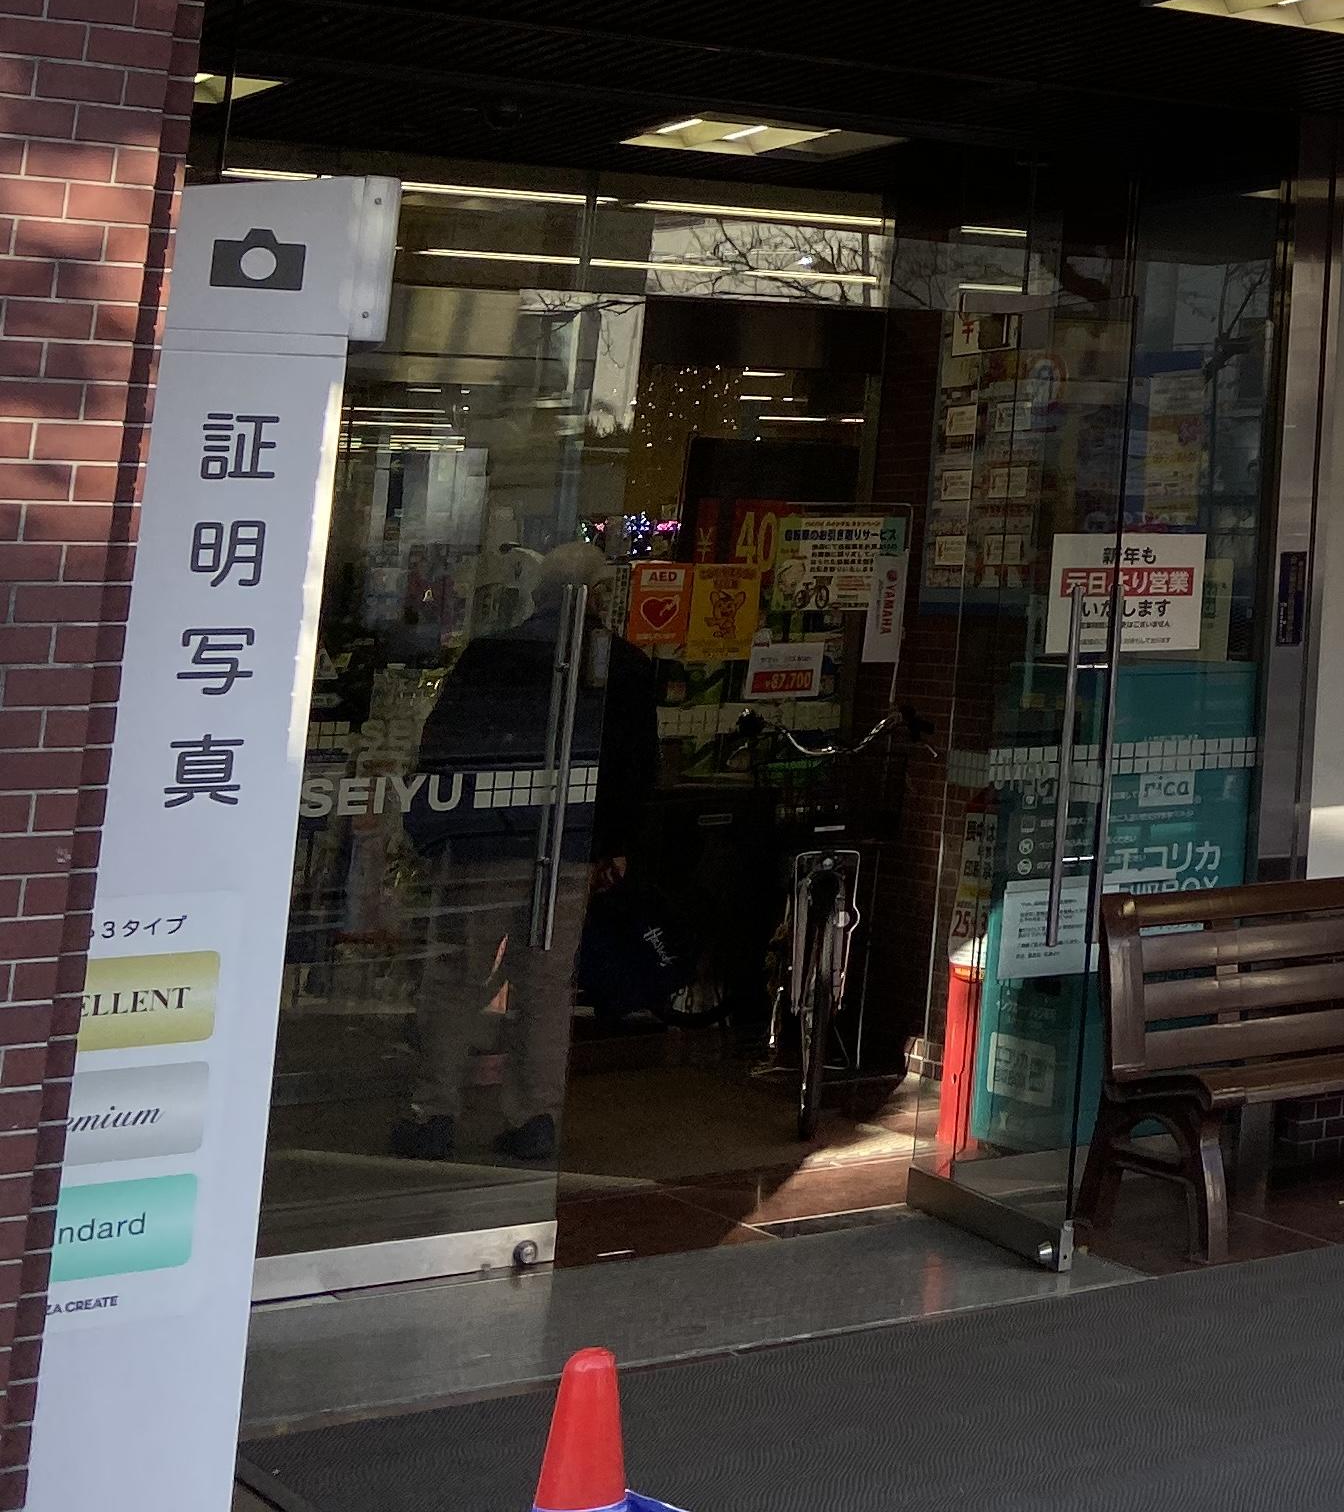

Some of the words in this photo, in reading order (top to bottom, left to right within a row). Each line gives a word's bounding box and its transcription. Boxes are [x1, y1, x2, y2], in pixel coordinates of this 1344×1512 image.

[1103, 547, 1157, 565] 新年も
[649, 571, 678, 583] AED
[1066, 571, 1190, 595] 元日より営業
[163, 411, 280, 809] 証明写真
[880, 585, 897, 635] YAMAHA
[299, 772, 465, 819] SEIYU
[1114, 840, 1221, 874] エコリカ
[57, 1211, 147, 1245] ndard
[65, 1295, 119, 1313] CREATE
